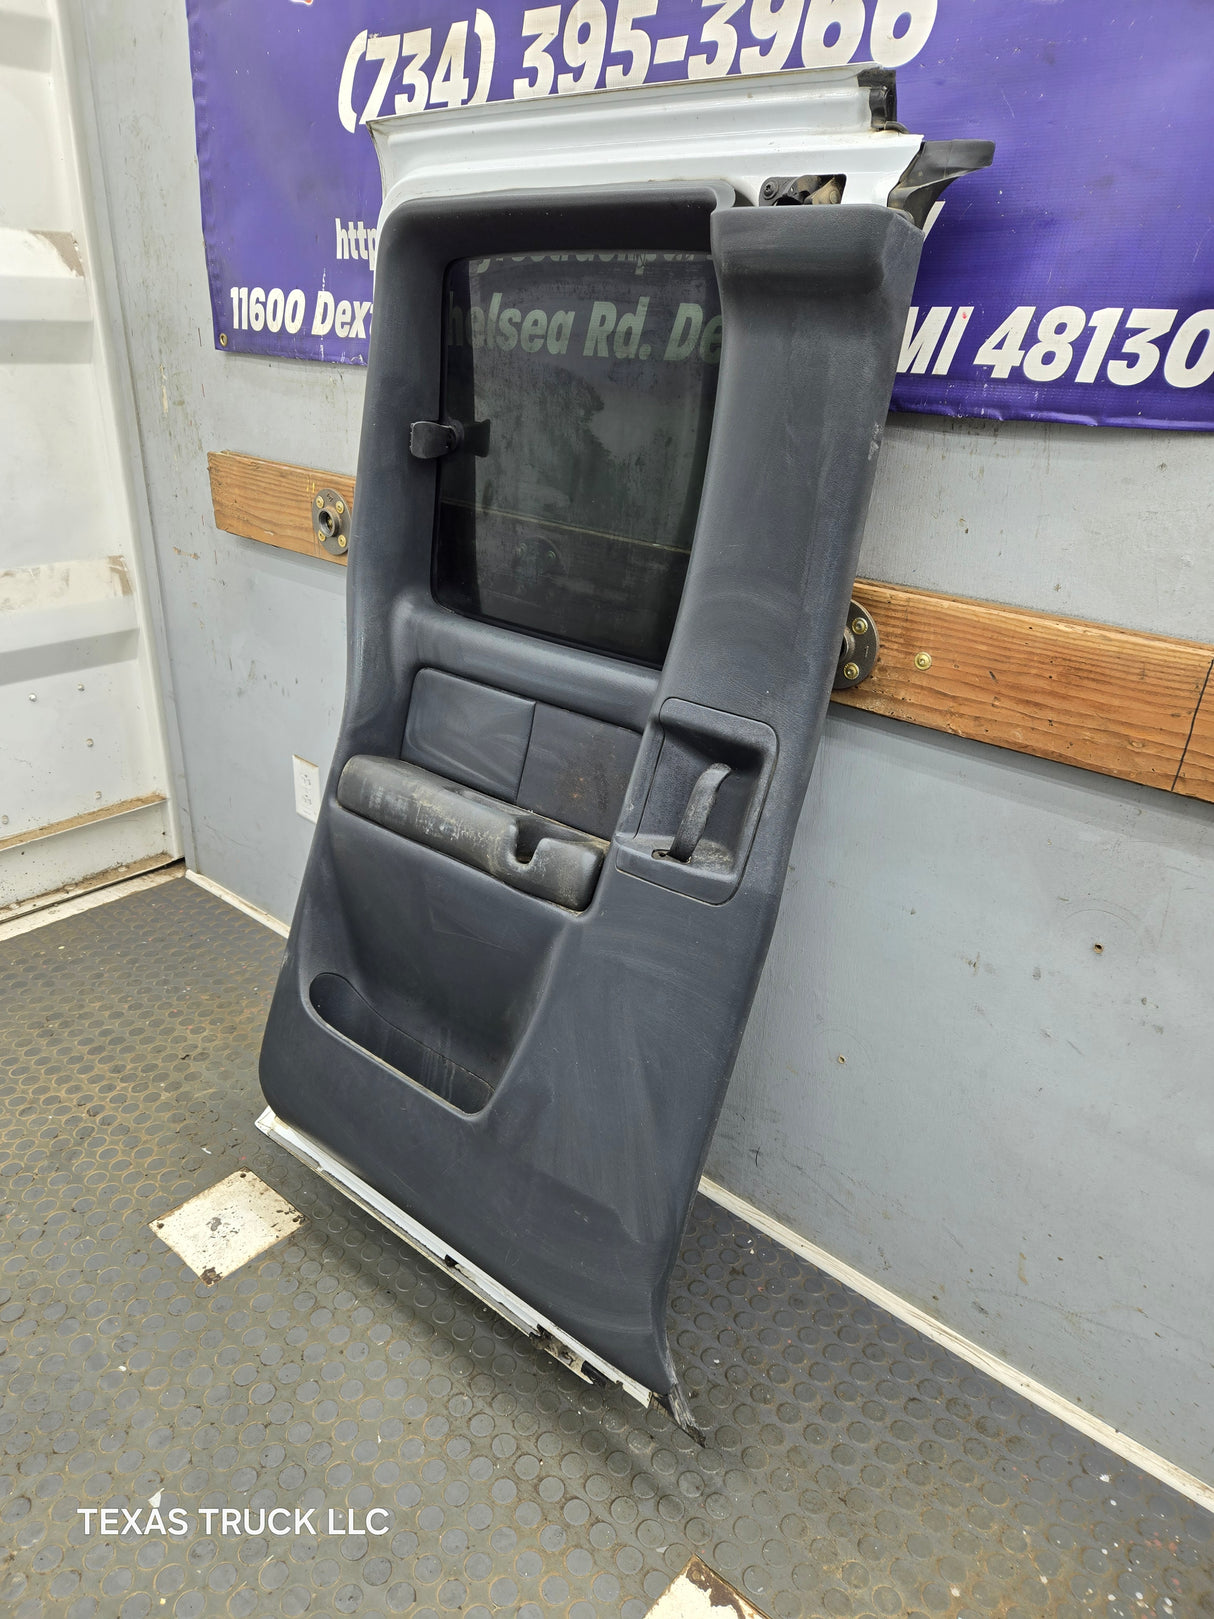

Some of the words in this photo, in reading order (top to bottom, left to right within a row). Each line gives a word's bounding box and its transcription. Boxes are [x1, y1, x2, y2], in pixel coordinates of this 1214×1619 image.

[338, 8, 496, 133] (734)
[230, 287, 306, 334] 11600
[311, 291, 374, 339] Dex
[583, 297, 651, 360] Rd.
[973, 305, 1214, 388] 48130
